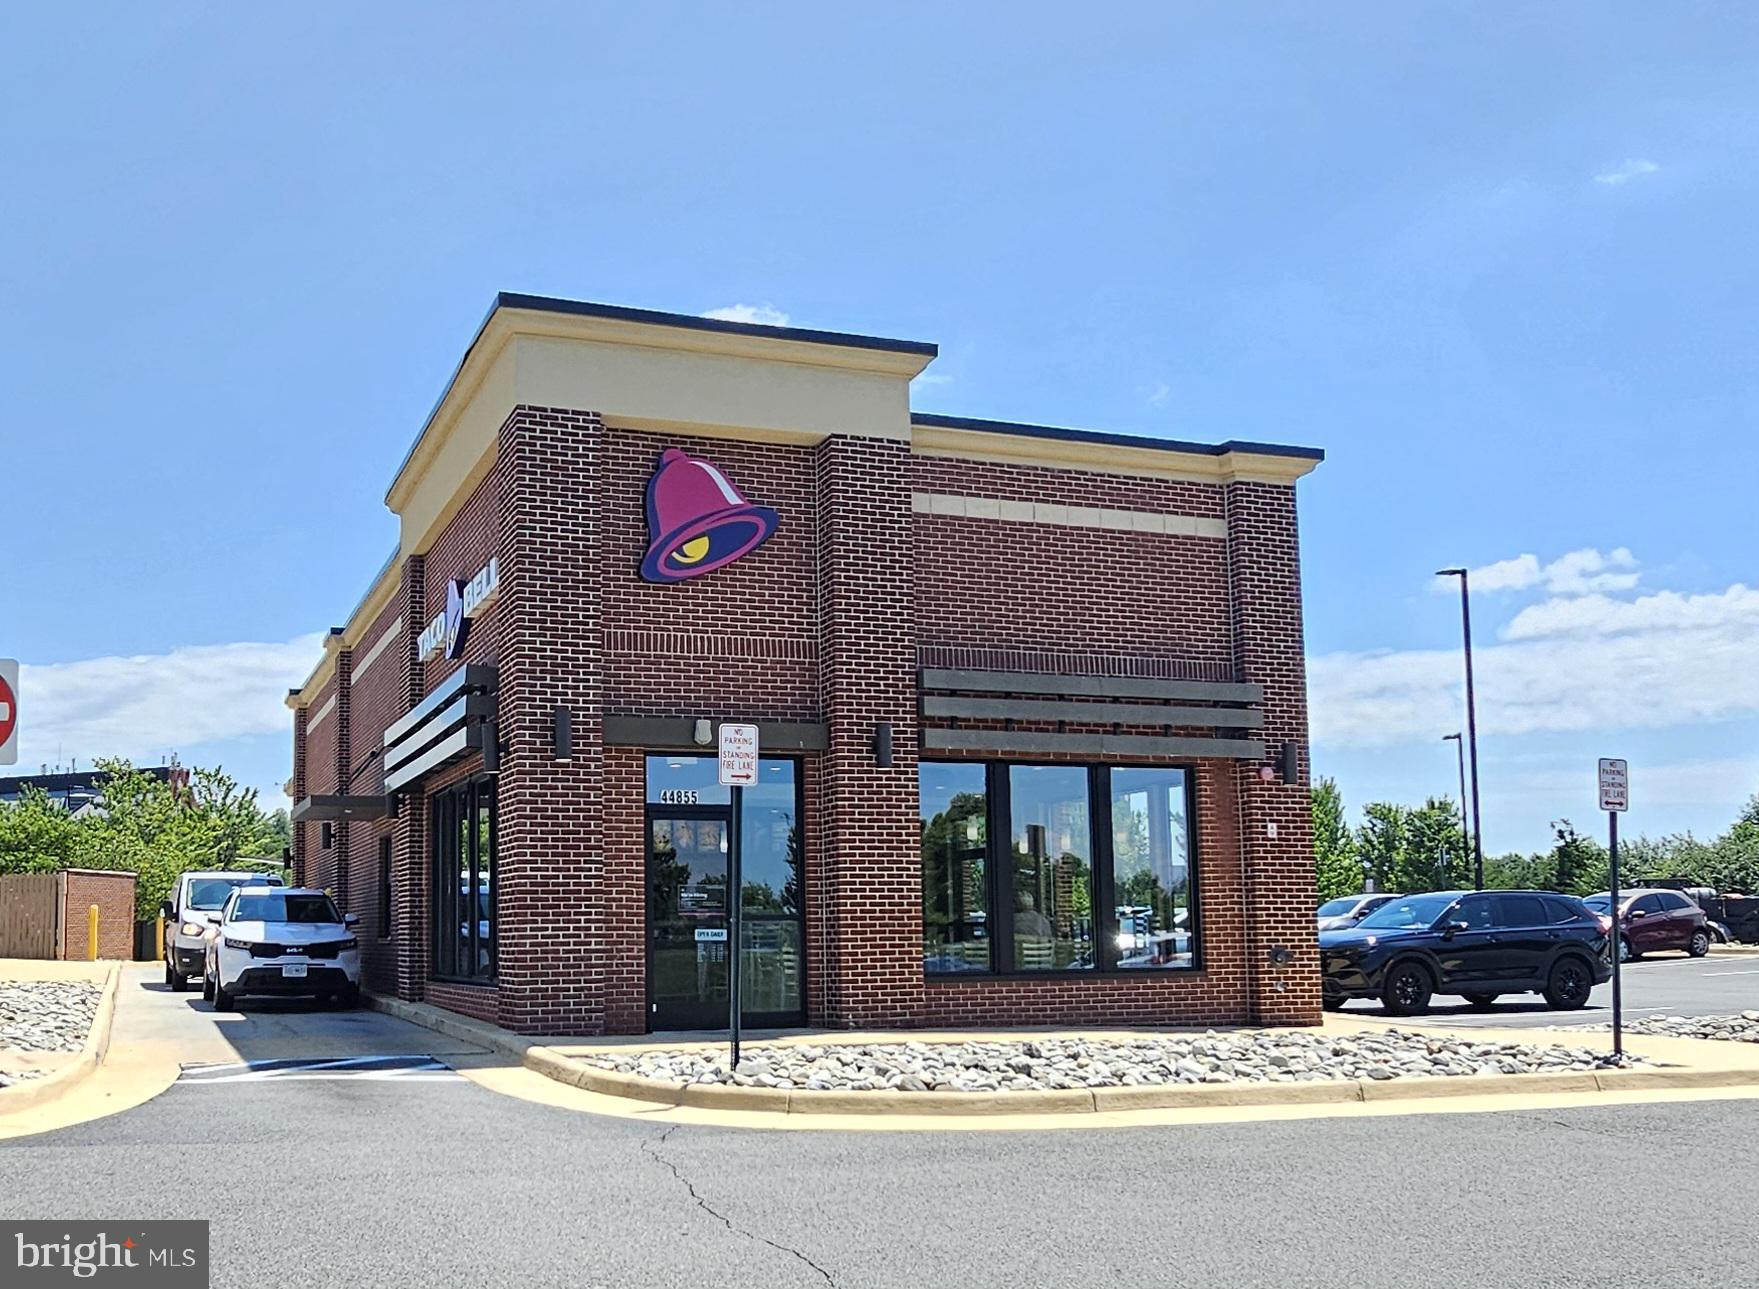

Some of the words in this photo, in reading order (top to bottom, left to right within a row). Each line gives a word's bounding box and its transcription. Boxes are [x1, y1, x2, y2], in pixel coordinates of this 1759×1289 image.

[417, 611, 446, 661] TACO
[724, 737, 753, 745] PARKING
[723, 751, 754, 759] STANDING
[723, 760, 735, 769] FIRE
[738, 761, 754, 770] LANE
[661, 790, 698, 804] 44855
